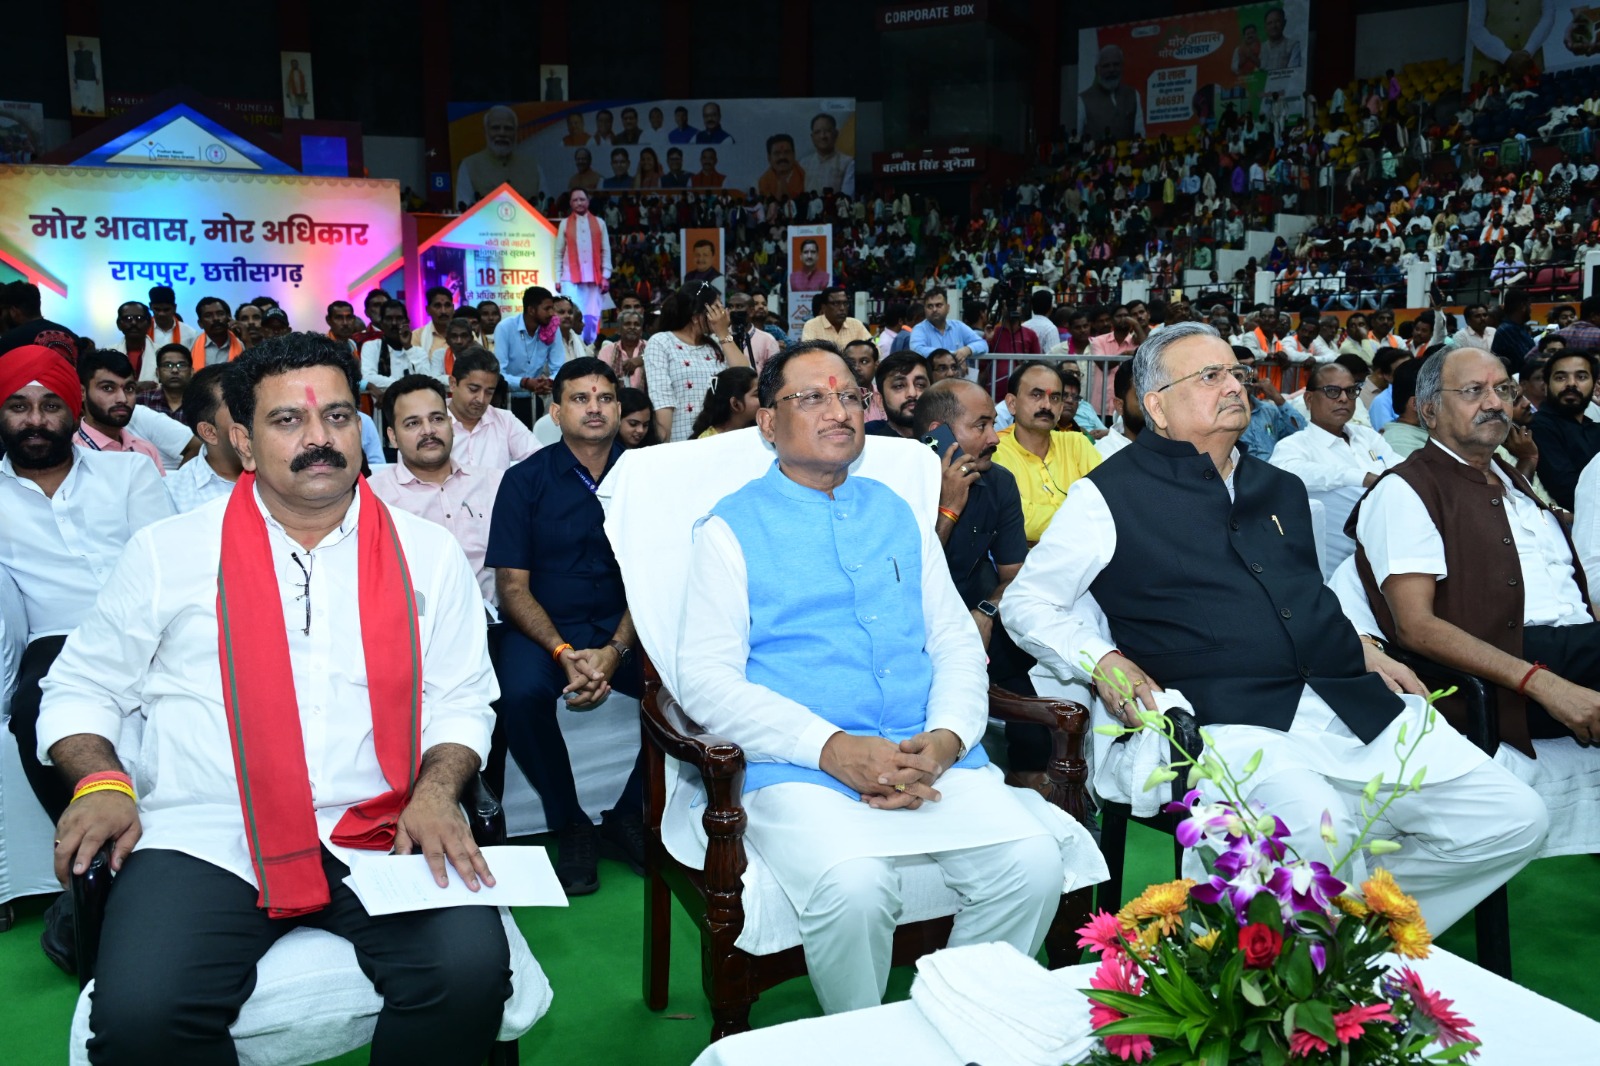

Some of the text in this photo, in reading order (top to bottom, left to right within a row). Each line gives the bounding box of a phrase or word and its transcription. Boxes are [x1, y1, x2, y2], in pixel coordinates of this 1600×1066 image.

[885, 4, 975, 24] CORPORATE BOX
[235, 103, 275, 113] JUNEJA
[943, 156, 976, 172] जुनेजा
[435, 176, 444, 188] 8
[29, 207, 369, 247] मोर आवास, मोर अधिकार
[108, 256, 304, 288] रायपुर, छत्तीसगढ़
[478, 268, 539, 286] 18 लाख
[476, 290, 496, 300] अधिक
[498, 290, 514, 300] गरीब
